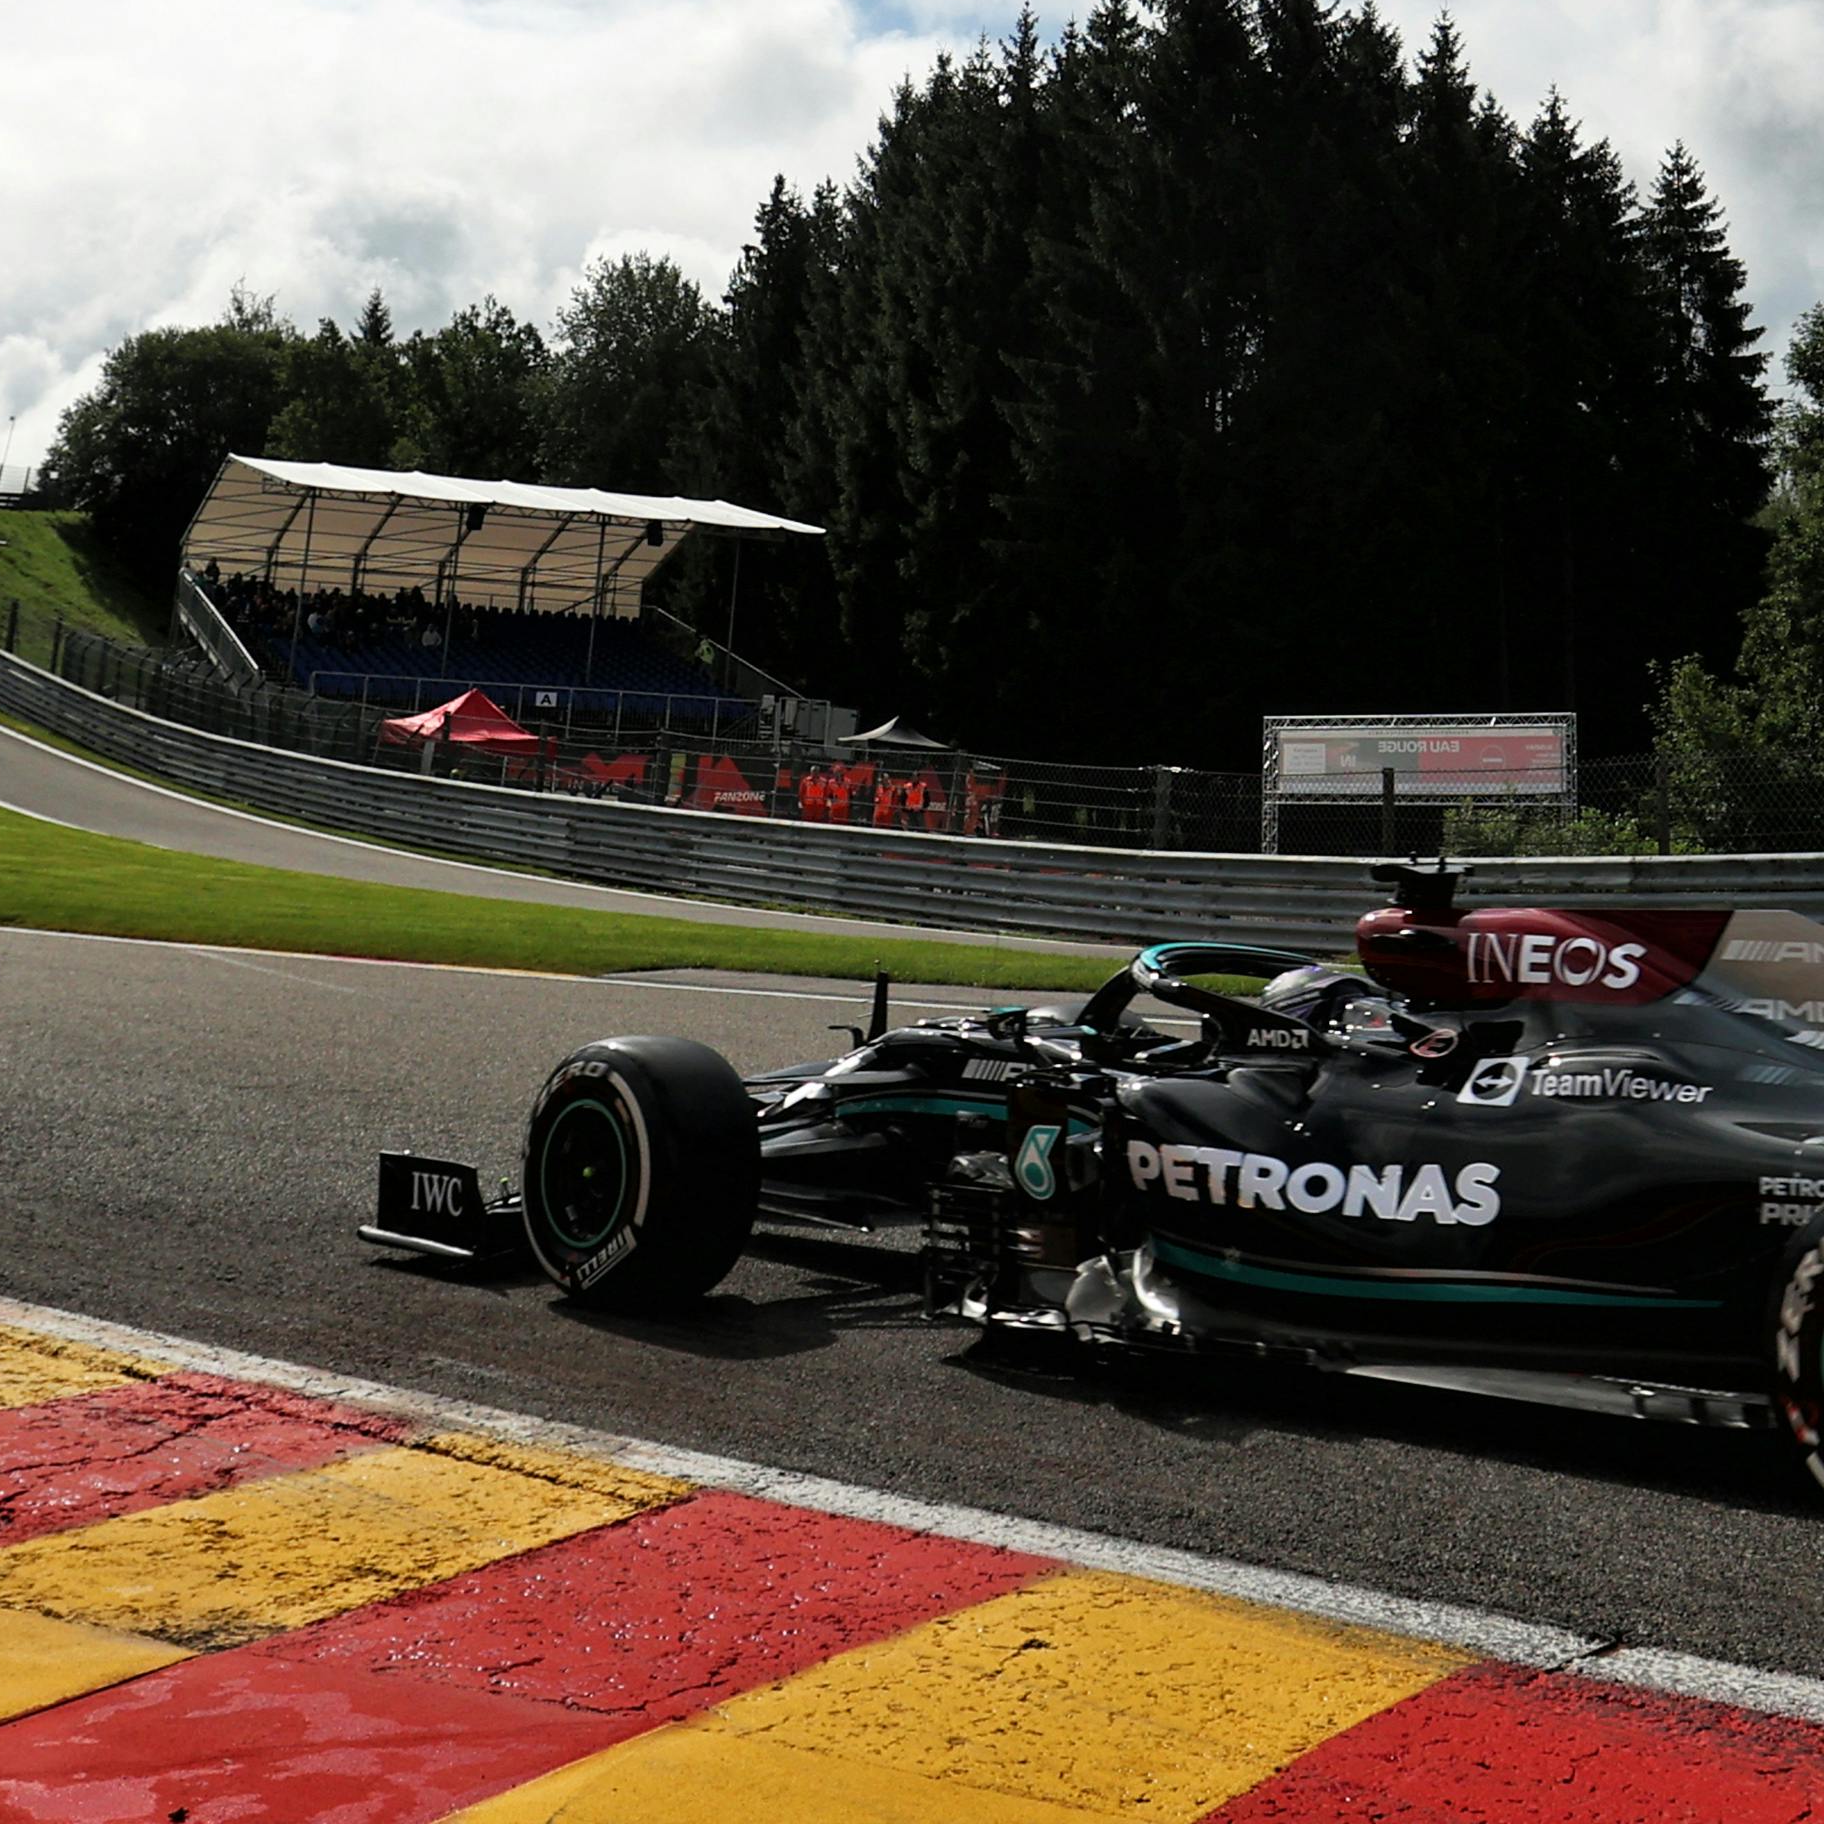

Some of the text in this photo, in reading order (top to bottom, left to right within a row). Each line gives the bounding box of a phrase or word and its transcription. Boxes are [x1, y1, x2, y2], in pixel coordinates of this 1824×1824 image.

[540, 693, 551, 705] A
[1466, 933, 1648, 989] INEOS
[1247, 1028, 1292, 1049] AMD
[1531, 1068, 1714, 1104] TeamViewer
[410, 1170, 464, 1217] IWC
[1125, 1139, 1503, 1227] PETRONAS
